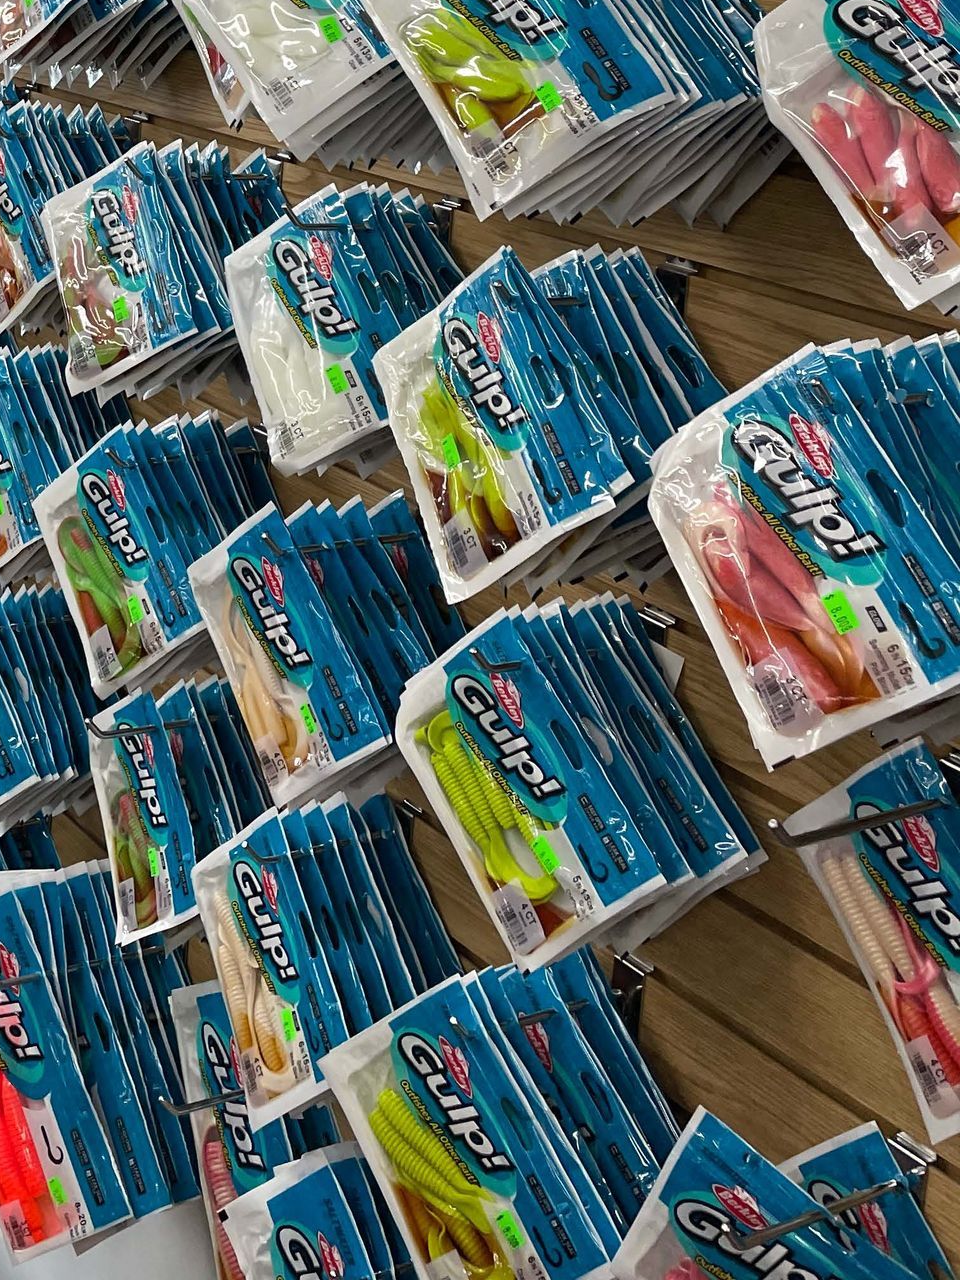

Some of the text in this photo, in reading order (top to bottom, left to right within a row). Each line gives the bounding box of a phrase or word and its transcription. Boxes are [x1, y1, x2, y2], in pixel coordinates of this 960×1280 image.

[470, 14, 482, 29] All
[480, 23, 501, 47] Other
[499, 41, 521, 61] Bait!
[839, 49, 949, 132] Outfishes All Other Bait!
[504, 141, 518, 155] CT
[271, 278, 317, 349] Outfishes All Other Bait!
[274, 240, 359, 337] Gulp!
[443, 318, 528, 429] Gulp!
[478, 316, 500, 363] Berkley
[294, 426, 304, 440] CT
[794, 422, 831, 476] Berkley
[82, 473, 148, 562] Gulp!
[729, 472, 822, 579] Outfishes All Other Bait!
[732, 421, 886, 560] Gulp!
[463, 526, 477, 549] 3 CT
[231, 557, 312, 668] Gulp!
[262, 558, 284, 606] Berkley
[452, 674, 565, 799] Gulp!
[492, 677, 523, 728] Berkley
[276, 759, 287, 771] CT
[455, 721, 531, 817] Outfishes All Other Bait!
[231, 901, 276, 994] Outfishes All Other Bait!
[234, 862, 298, 982] Gulp!
[521, 900, 538, 925] 4 CT
[859, 852, 950, 970] Outfishes All Other Bait!
[256, 1063, 263, 1077] CT
[398, 1033, 515, 1173] Gulp!
[442, 1038, 471, 1097] Berkley
[936, 1067, 949, 1084] CT
[400, 1080, 480, 1186] Outfishes All Other Bait!
